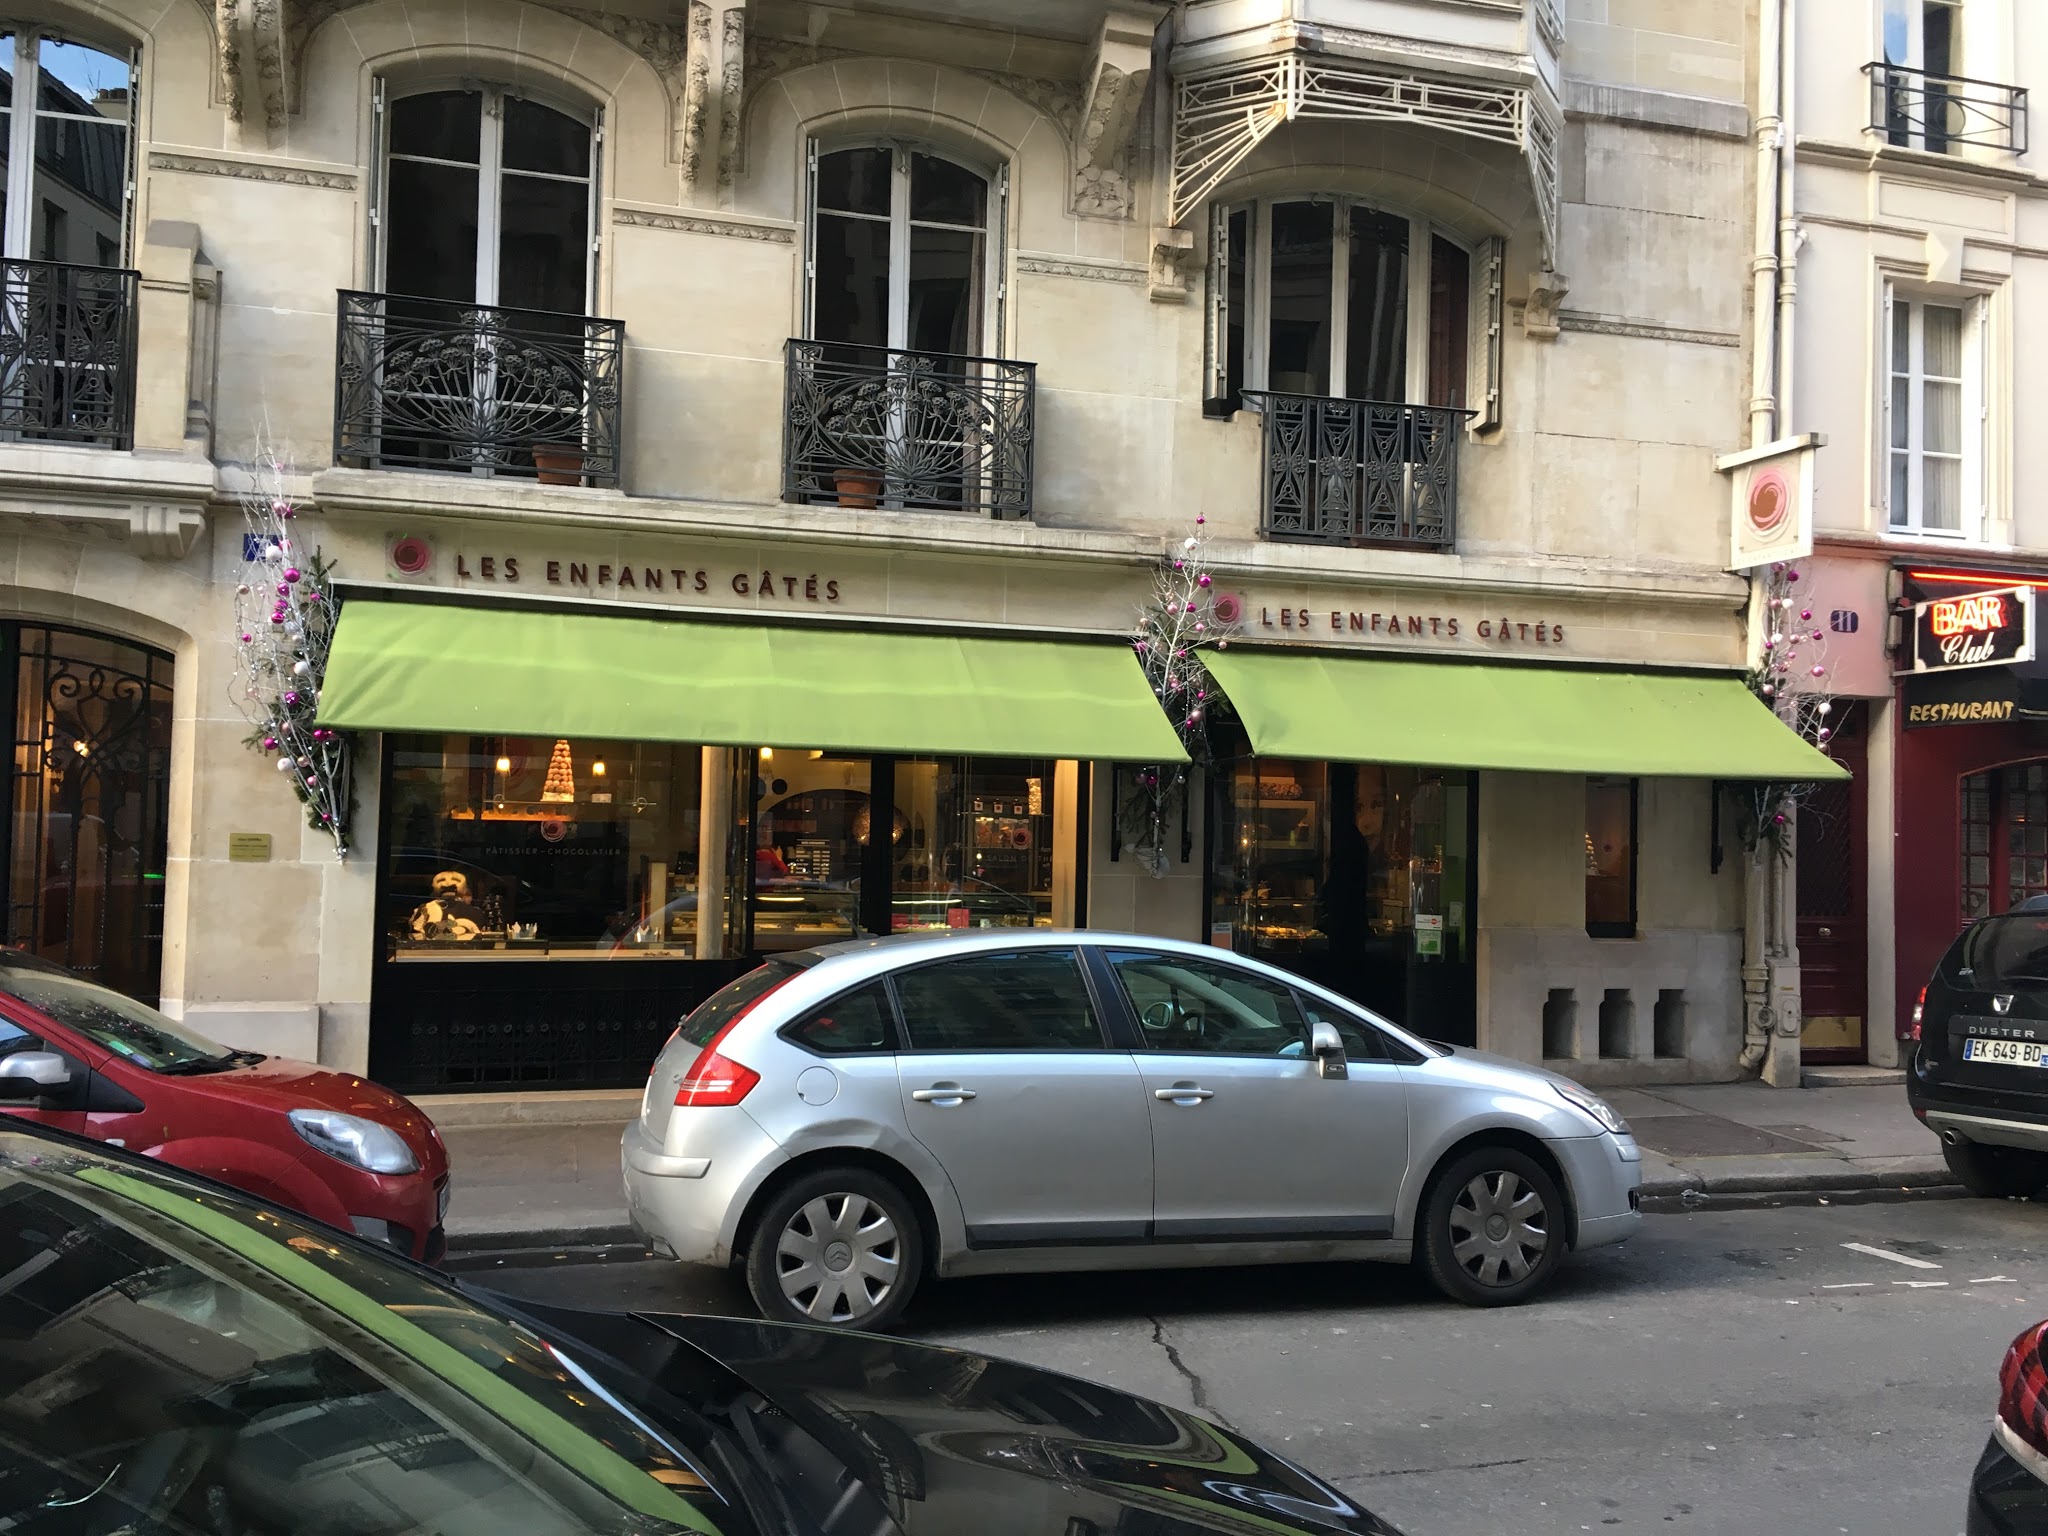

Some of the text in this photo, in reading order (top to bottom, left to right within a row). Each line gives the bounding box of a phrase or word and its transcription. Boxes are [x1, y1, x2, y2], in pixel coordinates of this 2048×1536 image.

[457, 554, 840, 600] LES ENFANTS GÂTÉS
[1261, 606, 1564, 643] LES ENFANTS GÂTÉS
[1838, 610, 1852, 632] 11
[1934, 597, 2004, 635] BAR
[1941, 632, 1995, 663] Club
[1910, 701, 2015, 722] RESTAURANT
[1968, 1026, 2035, 1038] DUSTER
[1973, 1040, 2042, 1062] EK-649-BD
